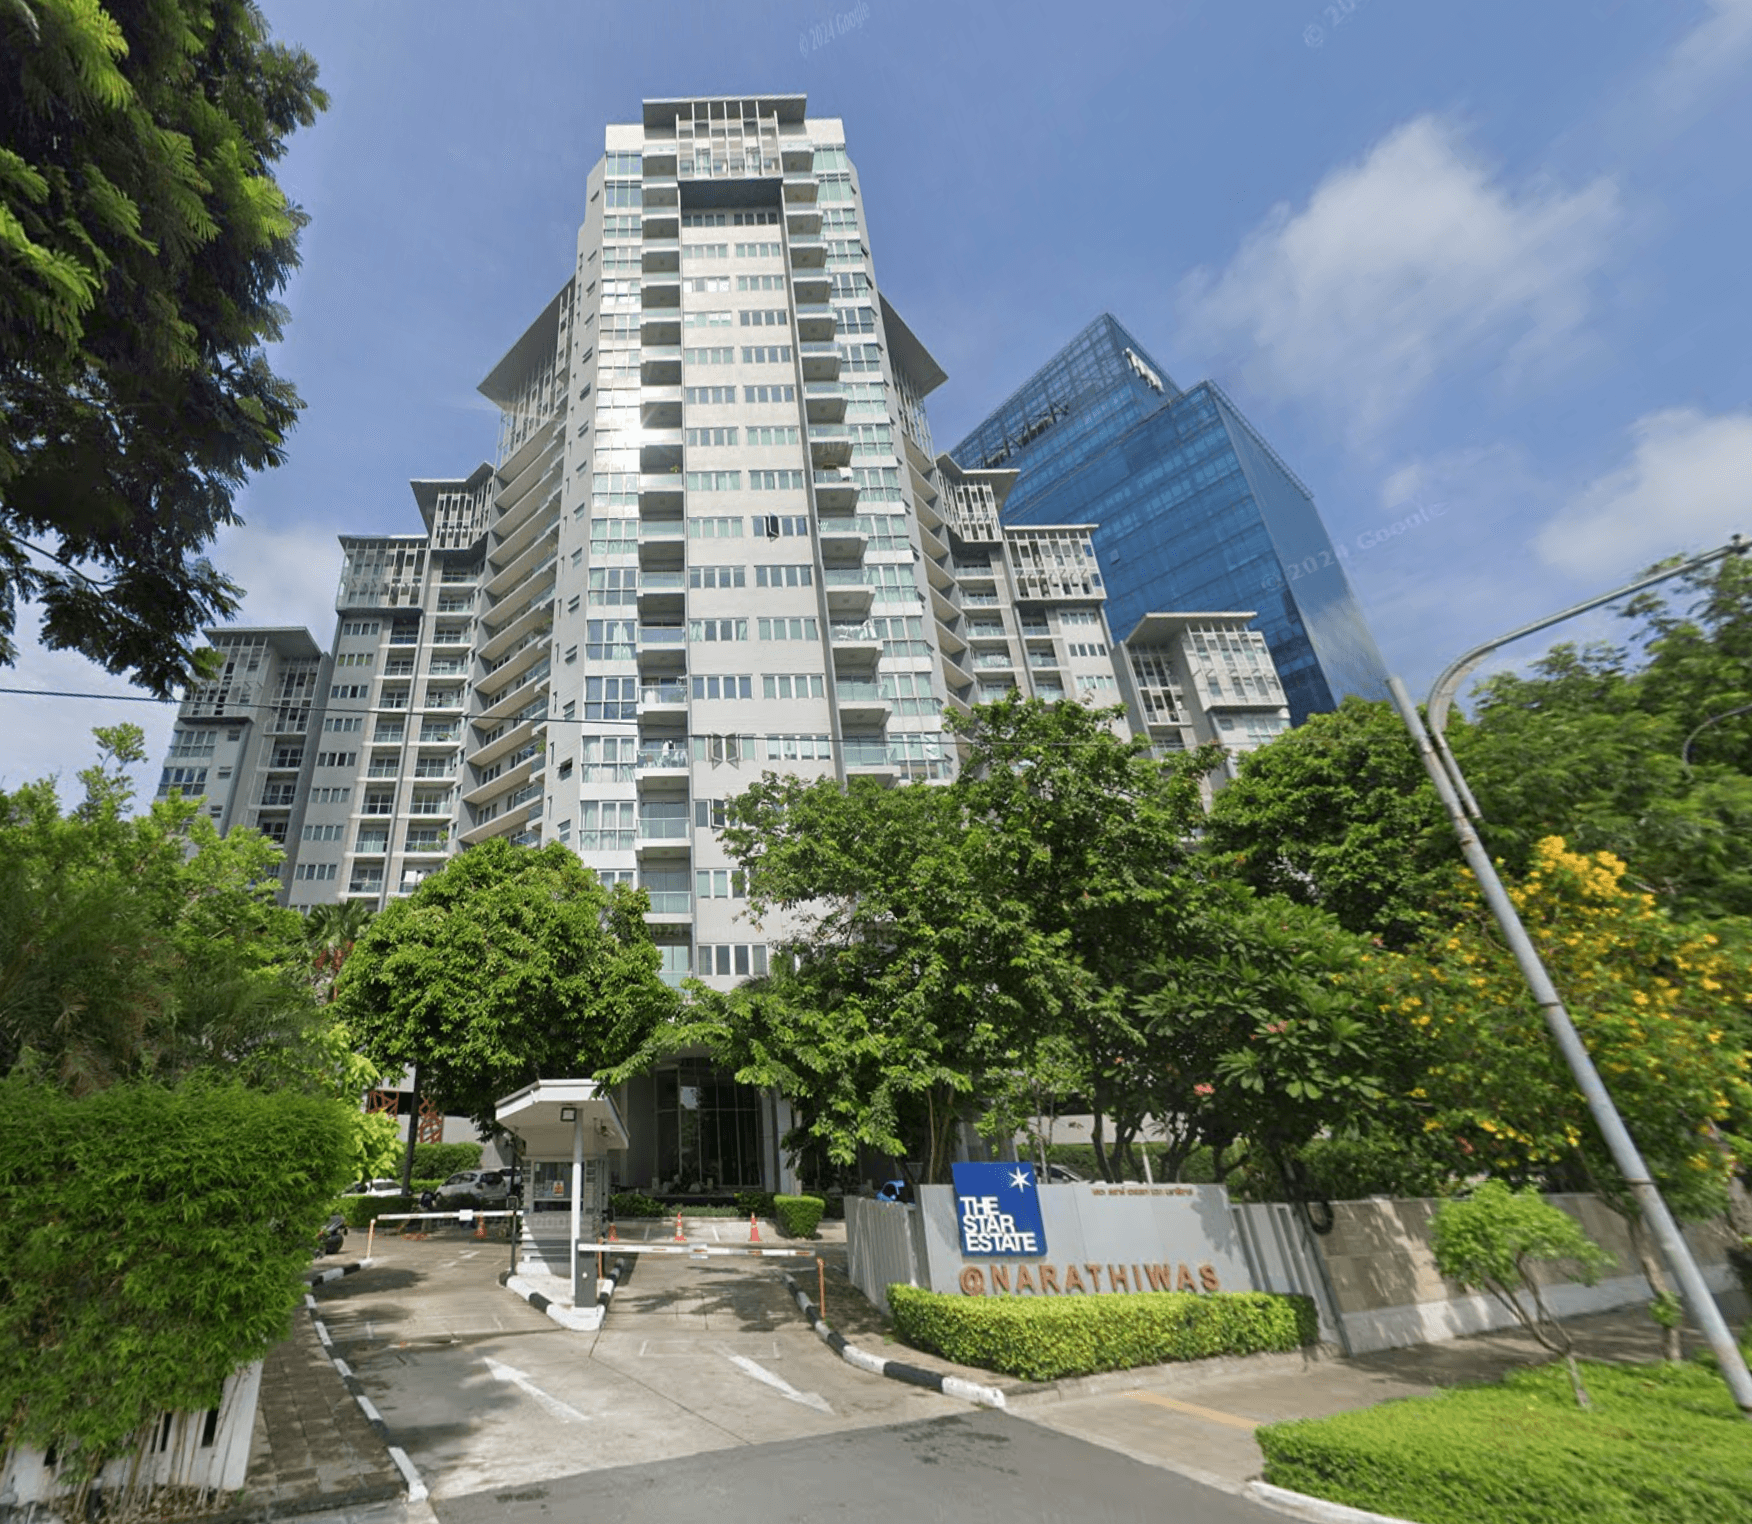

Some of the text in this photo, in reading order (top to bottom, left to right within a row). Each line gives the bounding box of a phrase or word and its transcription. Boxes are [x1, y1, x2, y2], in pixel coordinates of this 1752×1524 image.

[959, 1196, 1000, 1215] THE
[962, 1214, 1016, 1234] STAR
[965, 1232, 1038, 1252] ESTATE
[959, 1264, 1220, 1296] @NARATHIWAS
